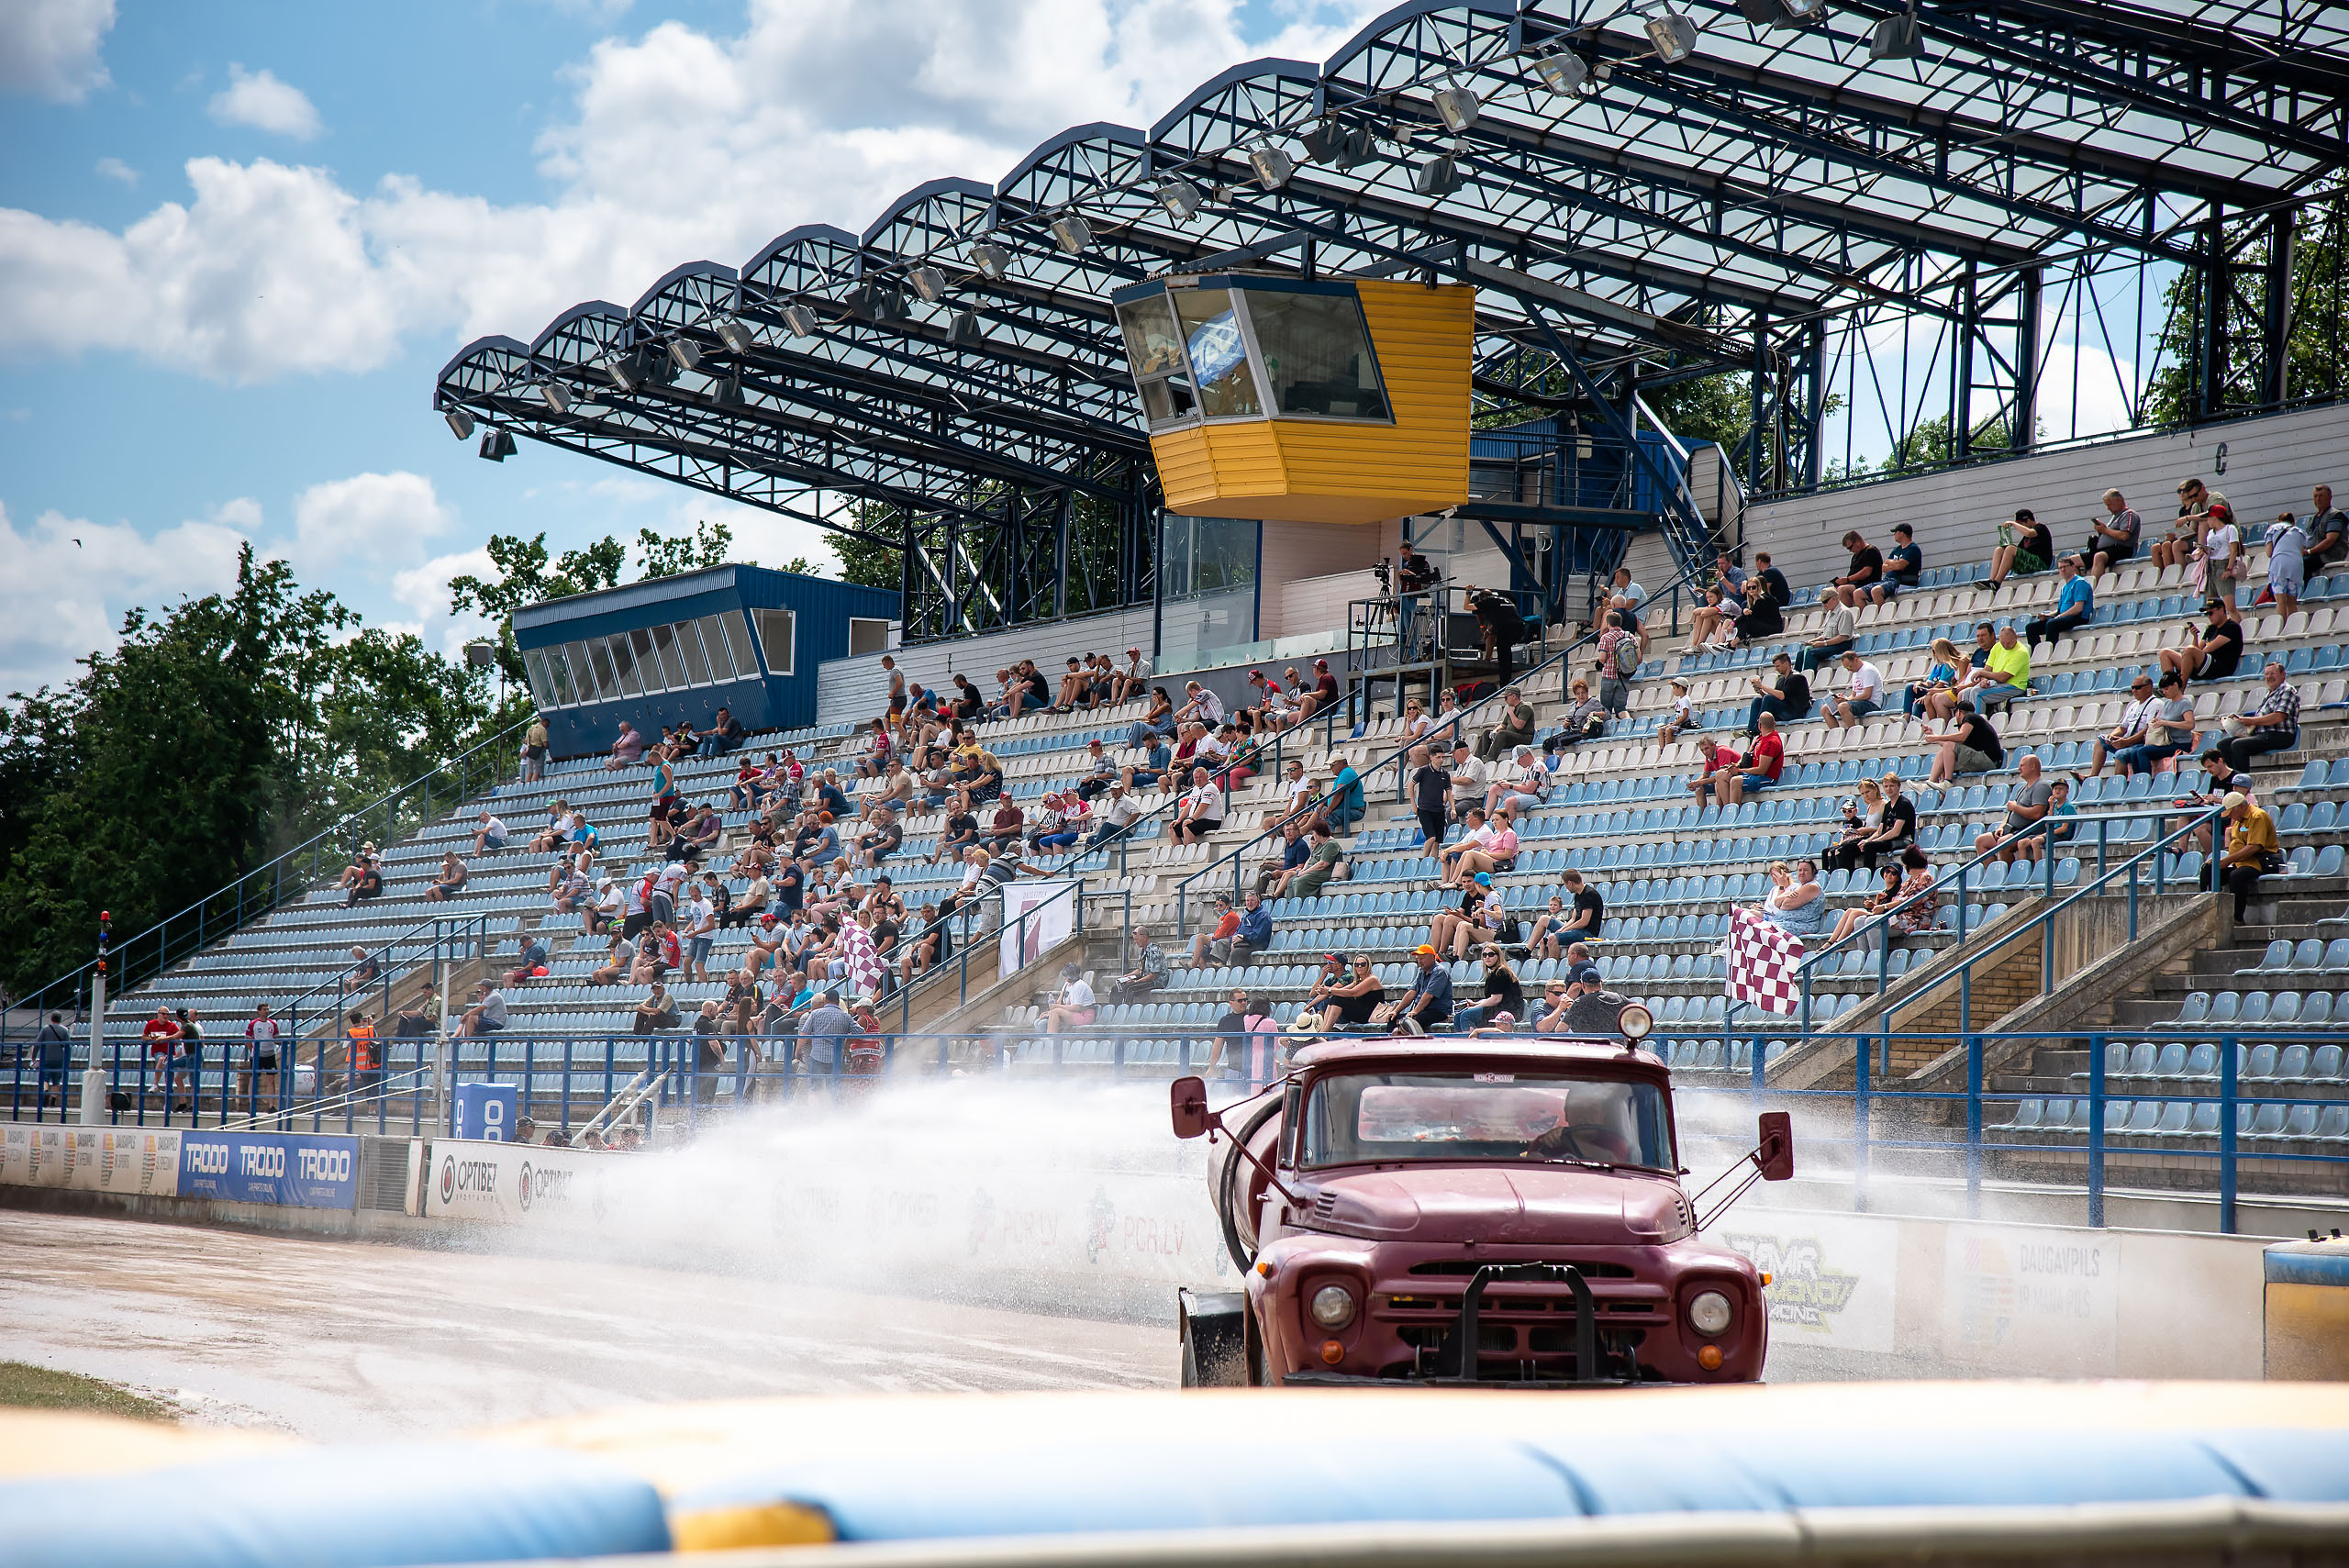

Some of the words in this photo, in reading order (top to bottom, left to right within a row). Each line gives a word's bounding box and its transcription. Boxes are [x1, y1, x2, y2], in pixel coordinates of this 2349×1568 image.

[2216, 442, 2228, 475] C
[185, 1143, 229, 1174] TRODO
[239, 1145, 285, 1178] TRODO
[297, 1148, 351, 1182] TRODO
[458, 1161, 497, 1192] OPTIBET
[2020, 1243, 2099, 1277] DAUGAVPILS
